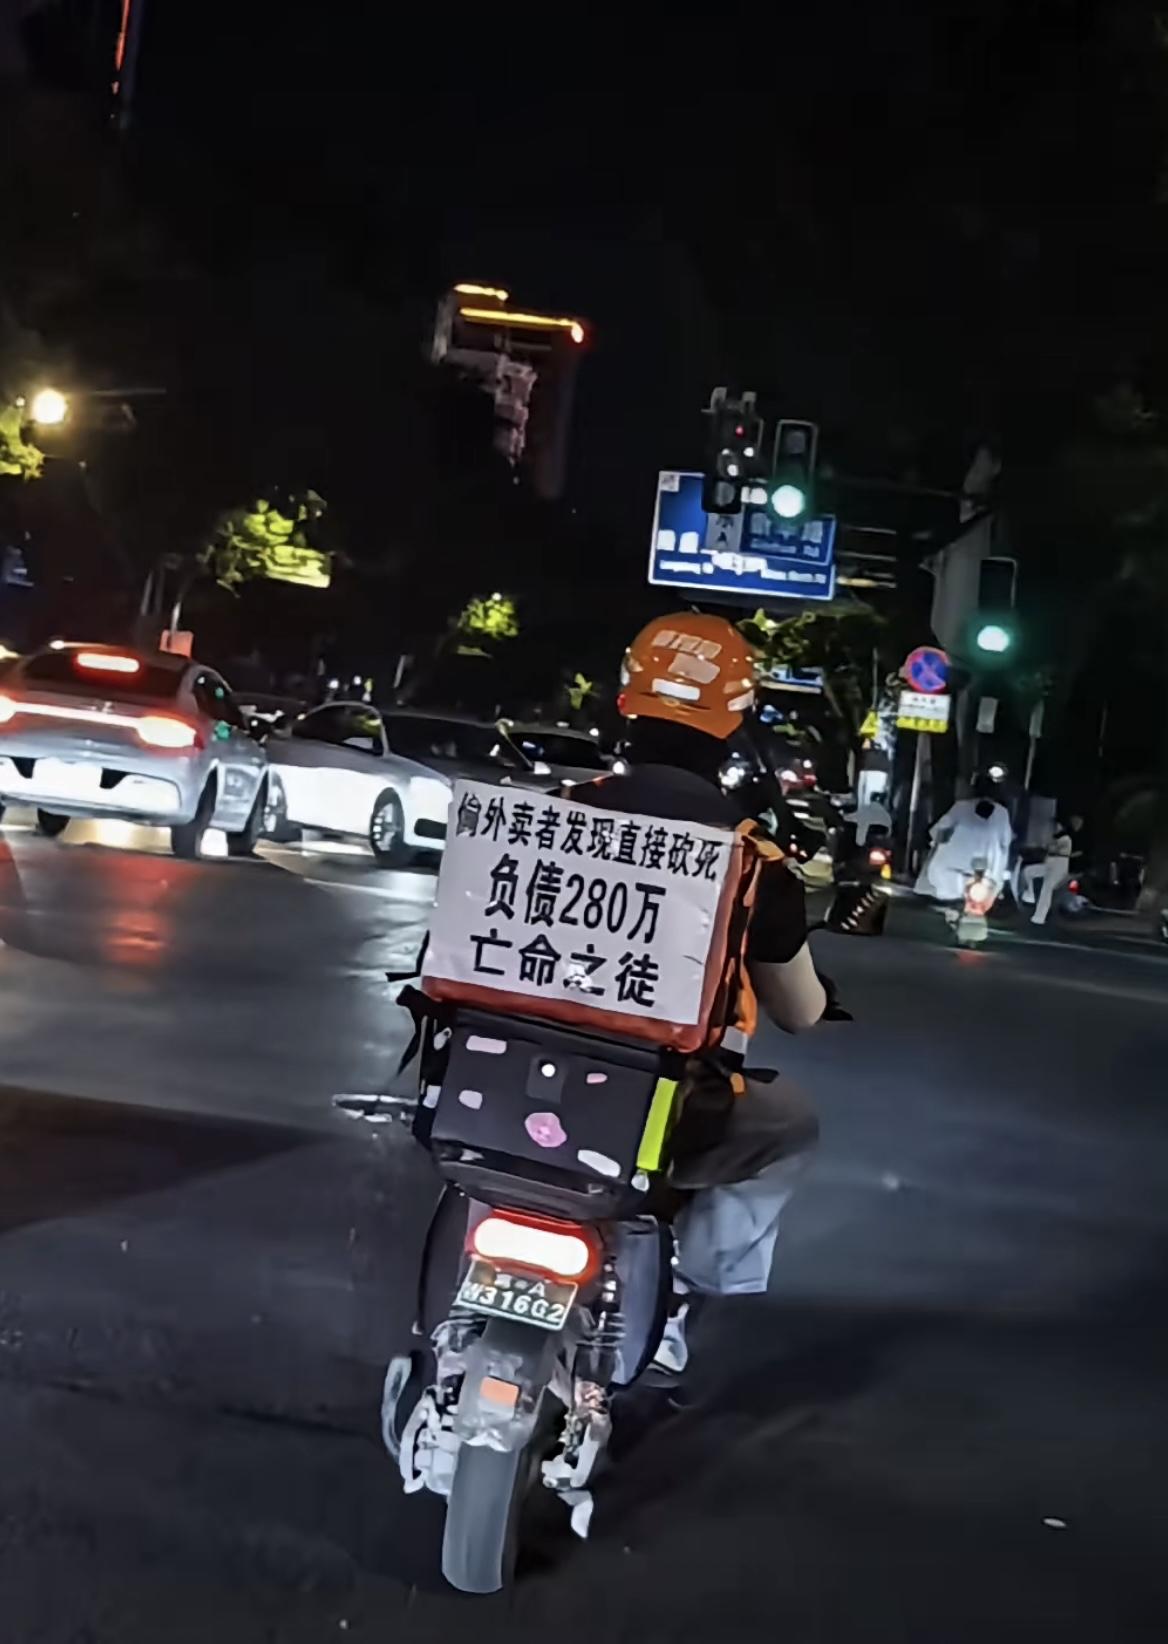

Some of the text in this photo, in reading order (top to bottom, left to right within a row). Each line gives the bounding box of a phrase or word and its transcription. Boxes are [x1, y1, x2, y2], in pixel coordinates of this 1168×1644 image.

[485, 853, 666, 943] 负债280万
[470, 929, 659, 1007] 亡命之徒
